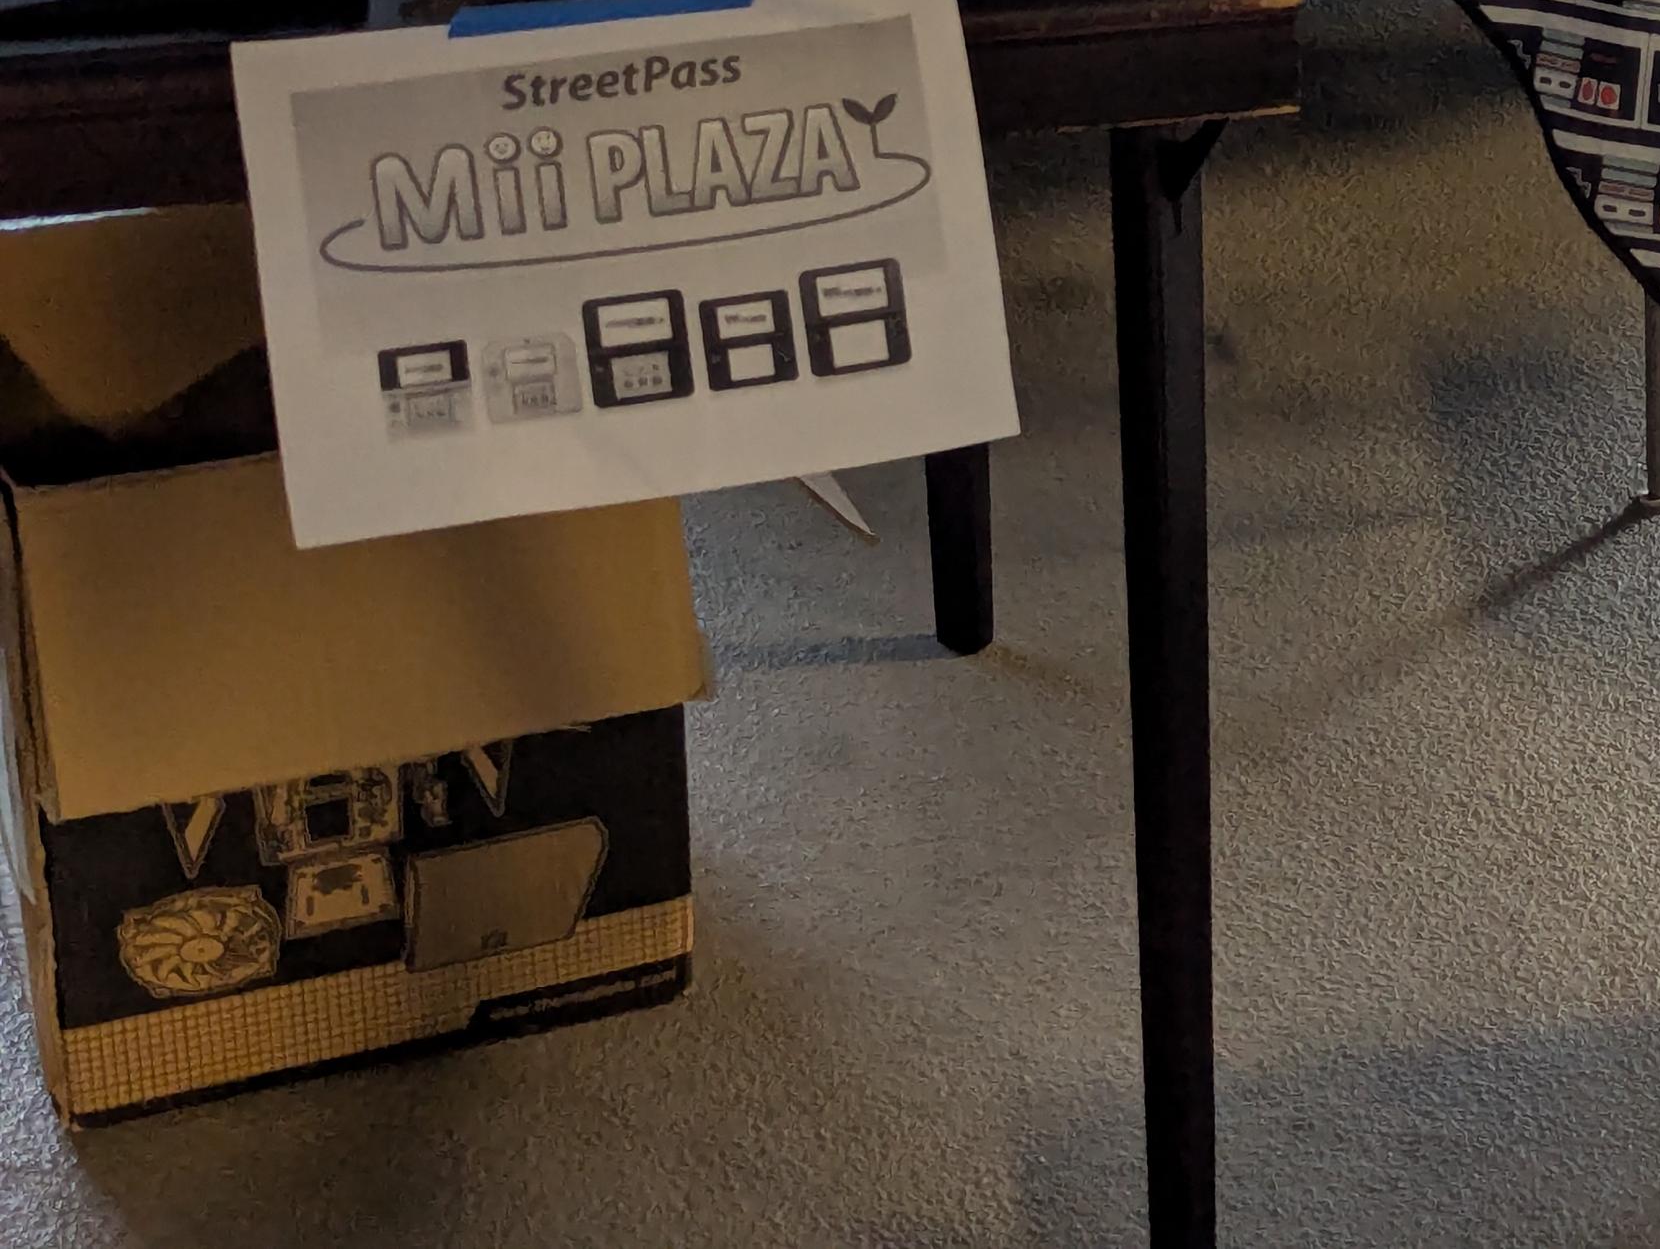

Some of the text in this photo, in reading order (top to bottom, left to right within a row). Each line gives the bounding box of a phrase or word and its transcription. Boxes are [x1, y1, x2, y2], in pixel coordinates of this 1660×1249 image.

[502, 53, 742, 112] StreetPass
[370, 103, 860, 251] Mii PLAZA
